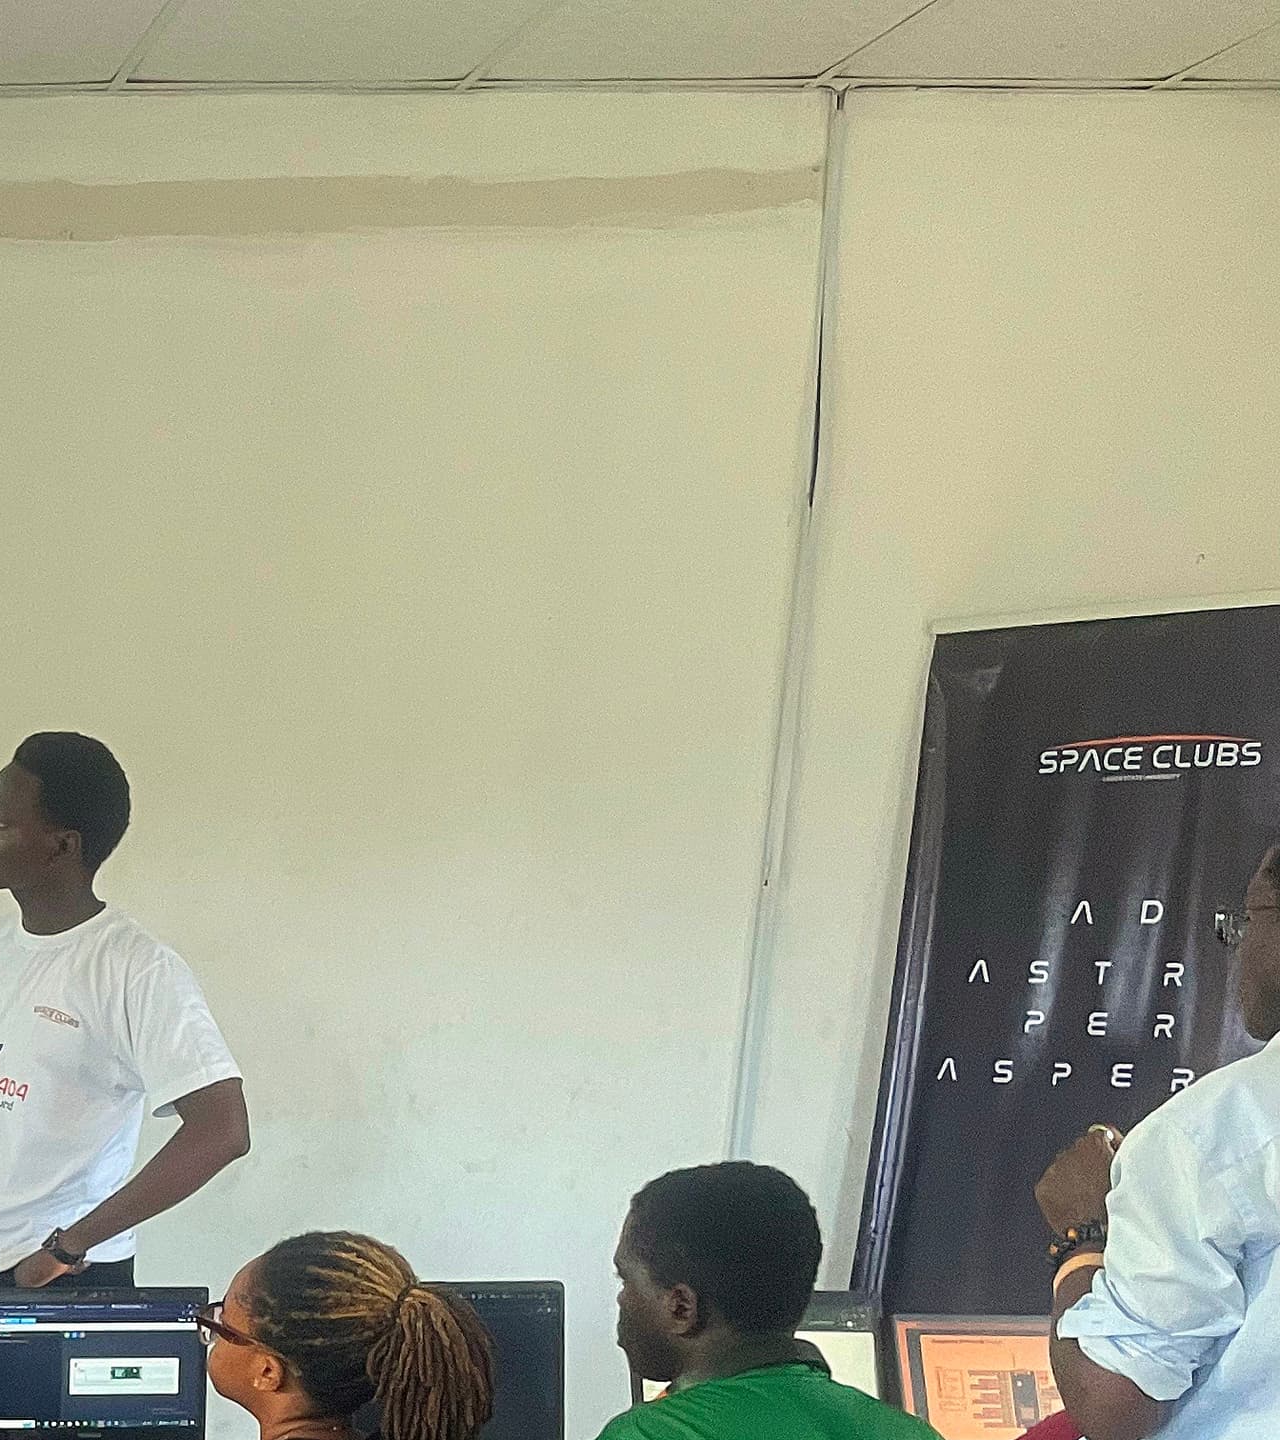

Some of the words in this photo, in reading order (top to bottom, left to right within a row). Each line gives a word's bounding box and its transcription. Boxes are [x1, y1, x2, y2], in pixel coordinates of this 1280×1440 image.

[1038, 746, 1144, 774] SPACE
[1152, 742, 1262, 769] CLUBS
[1070, 900, 1164, 925] AD
[968, 959, 1185, 987] ASTR
[1023, 1010, 1175, 1038] PER
[937, 1057, 1195, 1093] ASPER
